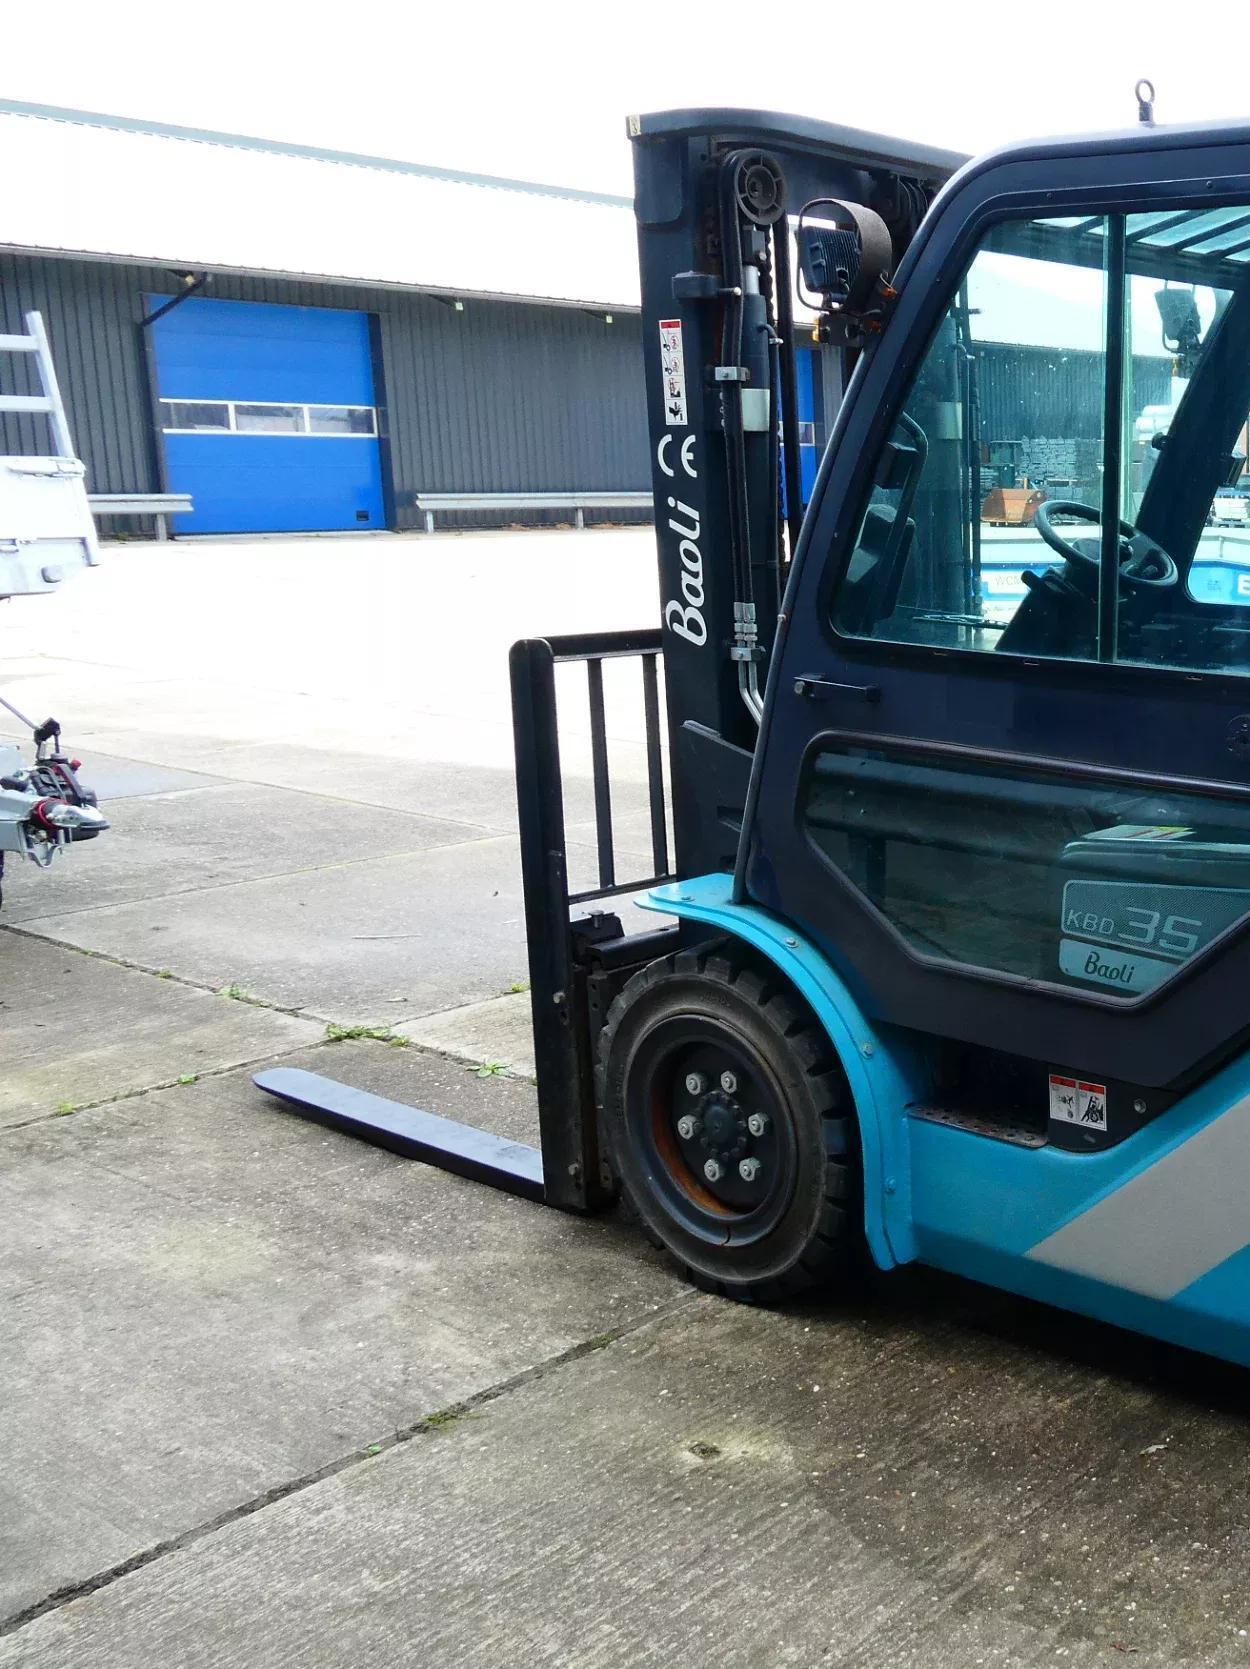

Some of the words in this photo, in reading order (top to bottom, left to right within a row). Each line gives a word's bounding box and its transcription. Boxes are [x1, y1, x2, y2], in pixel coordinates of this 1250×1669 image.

[665, 496, 707, 646] Baoli
[1066, 909, 1115, 936] KBD
[1117, 906, 1202, 952] 35
[1083, 951, 1136, 984] Baoli
